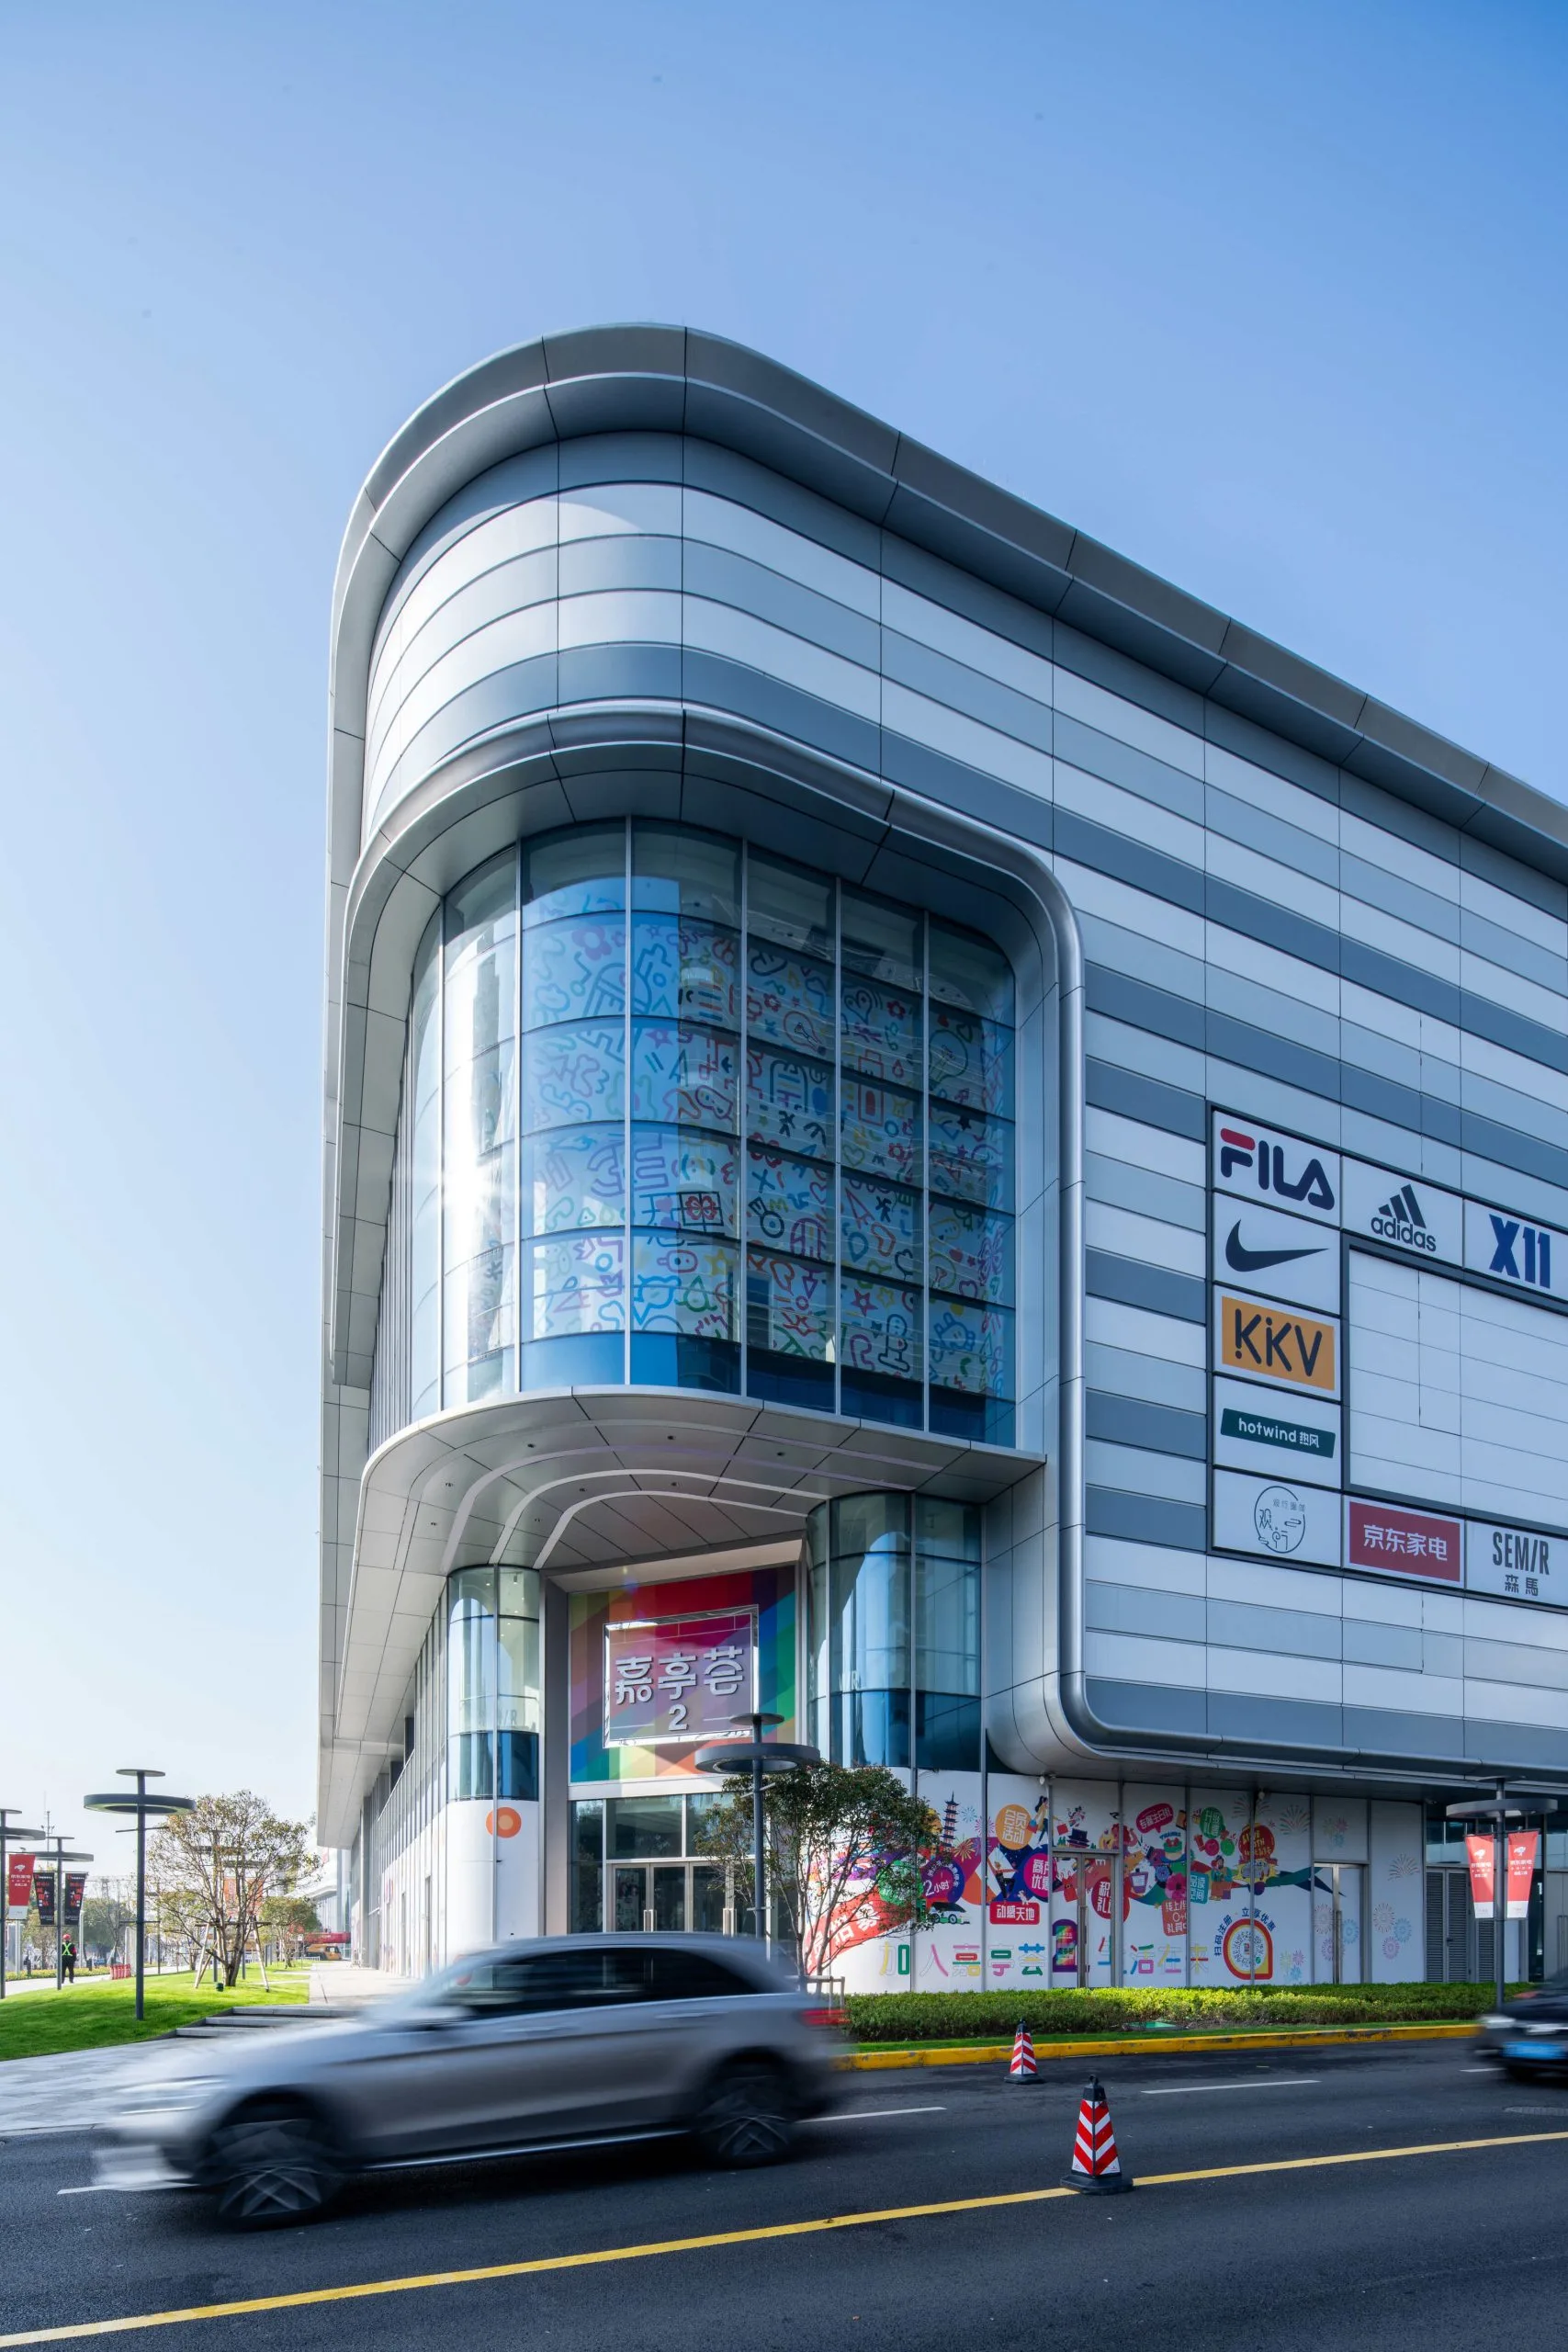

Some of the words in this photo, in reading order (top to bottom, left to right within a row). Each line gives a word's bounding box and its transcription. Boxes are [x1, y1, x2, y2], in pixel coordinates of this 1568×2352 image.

[1220, 1127, 1336, 1211] FILA
[1371, 1214, 1437, 1252] adidas
[1238, 1417, 1297, 1443] hotwind
[1299, 1431, 1320, 1449] 热风
[1363, 1524, 1448, 1562] 京东家电
[615, 1645, 744, 1706] 嘉亭荟
[668, 1703, 688, 1732] 2
[996, 1904, 1035, 1921] 动感天地
